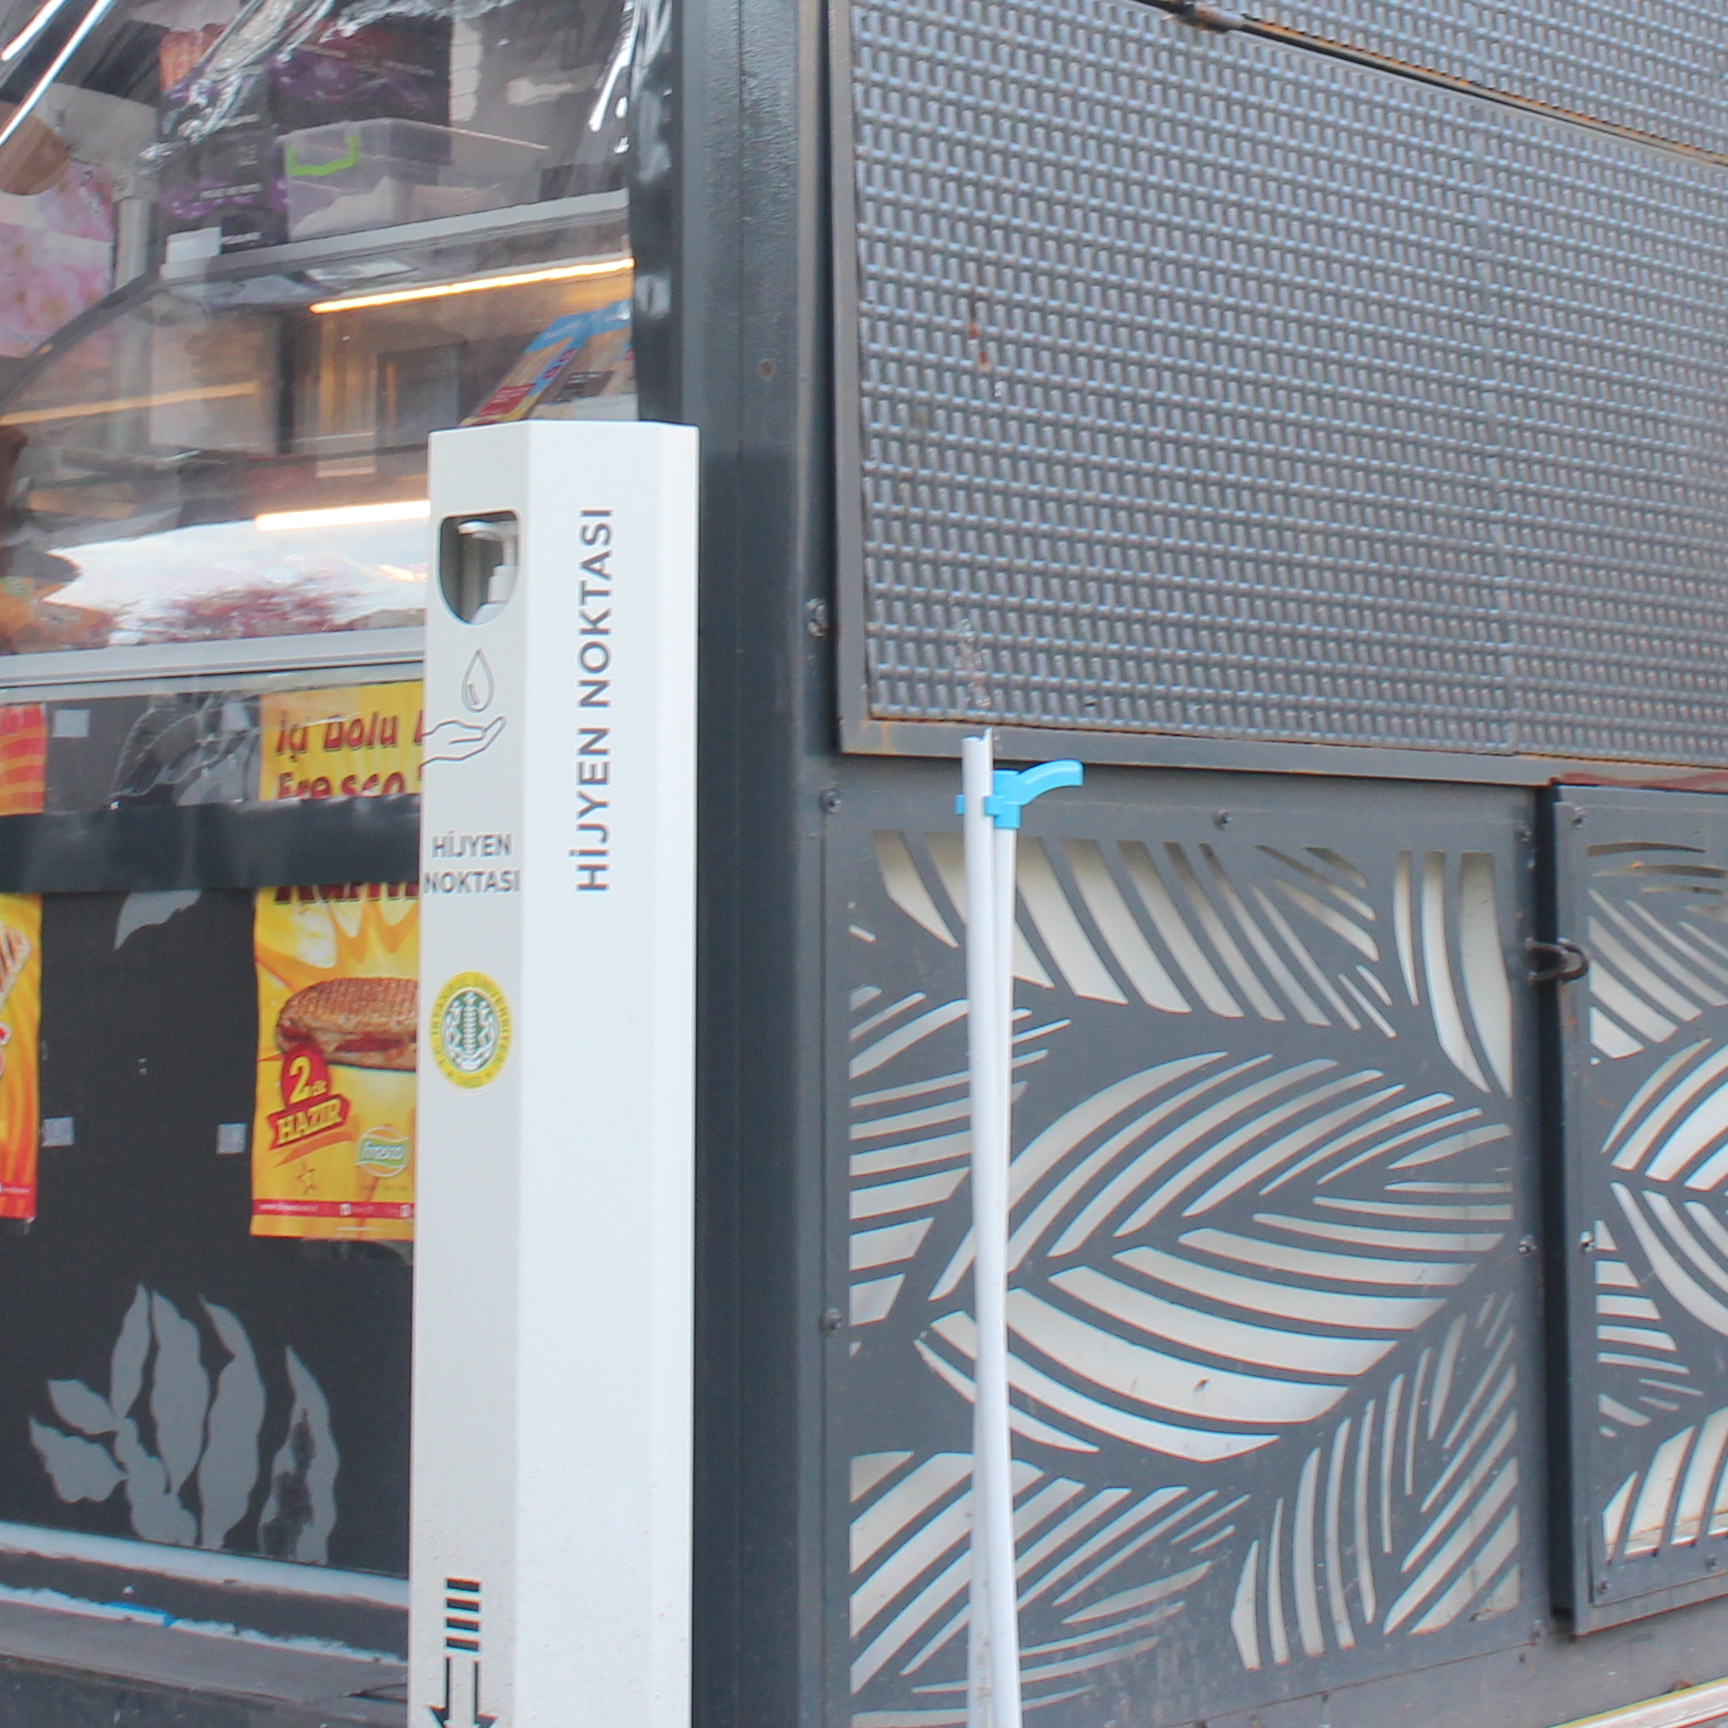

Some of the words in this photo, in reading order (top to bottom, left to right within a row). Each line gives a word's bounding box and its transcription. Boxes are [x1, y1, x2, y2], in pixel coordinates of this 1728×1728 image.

[576, 509, 613, 708] NOKTASI
[569, 727, 611, 891] HİJYEN
[432, 828, 512, 859] HİJYEN
[422, 870, 521, 894] NOKTASI
[288, 1056, 312, 1104] 2
[276, 1097, 343, 1145] HAZIR
